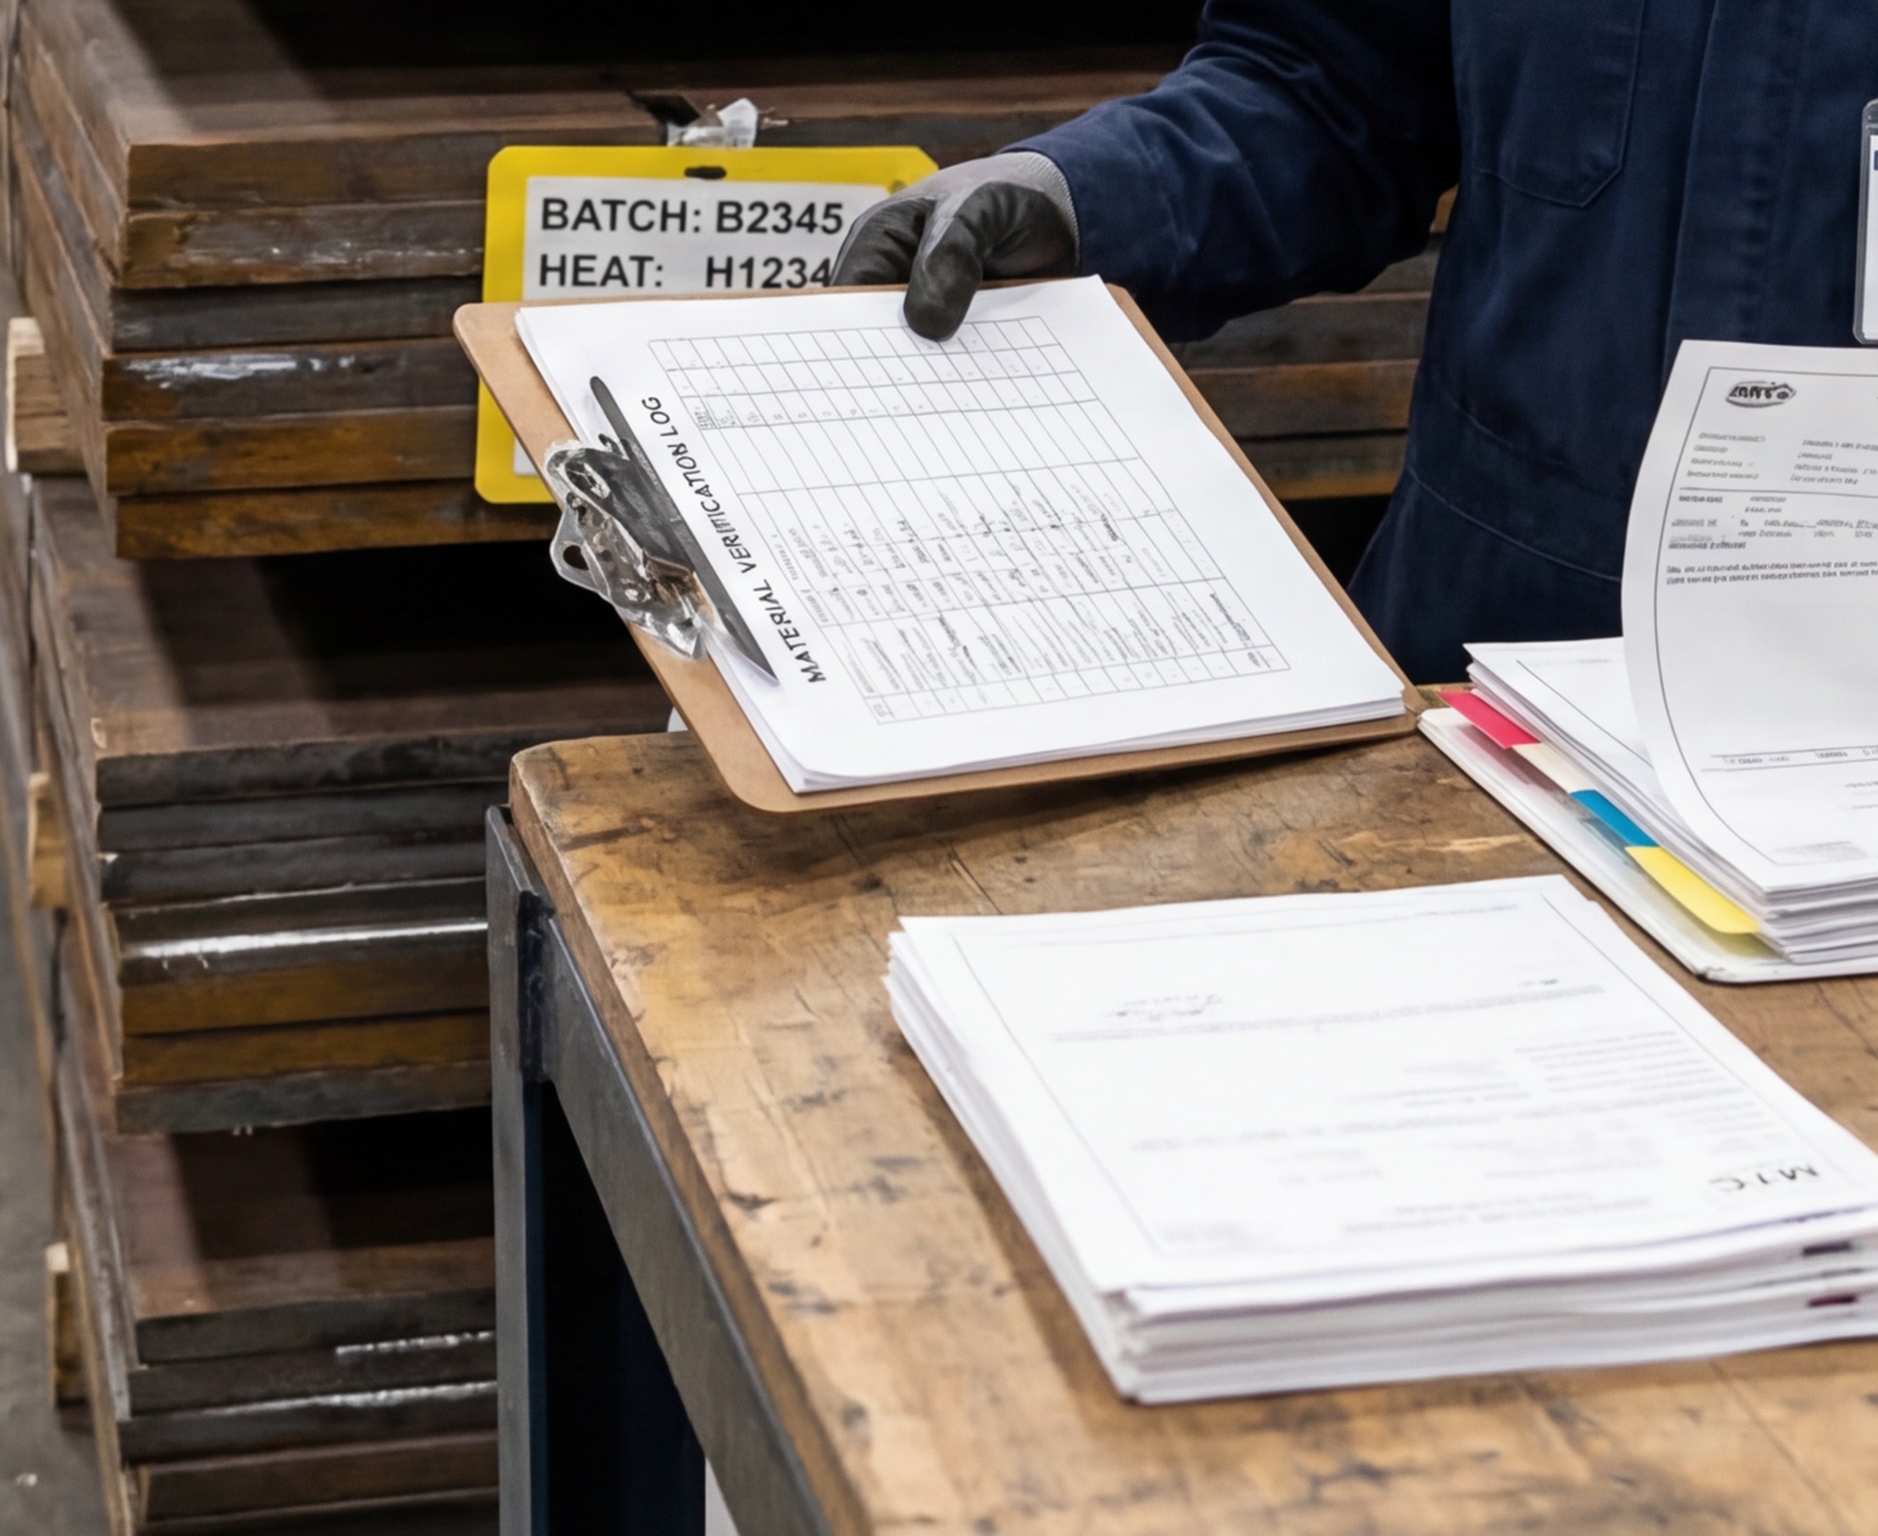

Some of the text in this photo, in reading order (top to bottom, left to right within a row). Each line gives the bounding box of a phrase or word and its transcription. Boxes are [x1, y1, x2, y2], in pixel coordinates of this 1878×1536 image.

[541, 197, 843, 235] BATCH: B2345
[539, 253, 663, 288] HEAT:
[640, 395, 679, 437] LOG
[752, 578, 826, 683] MATERIAL
